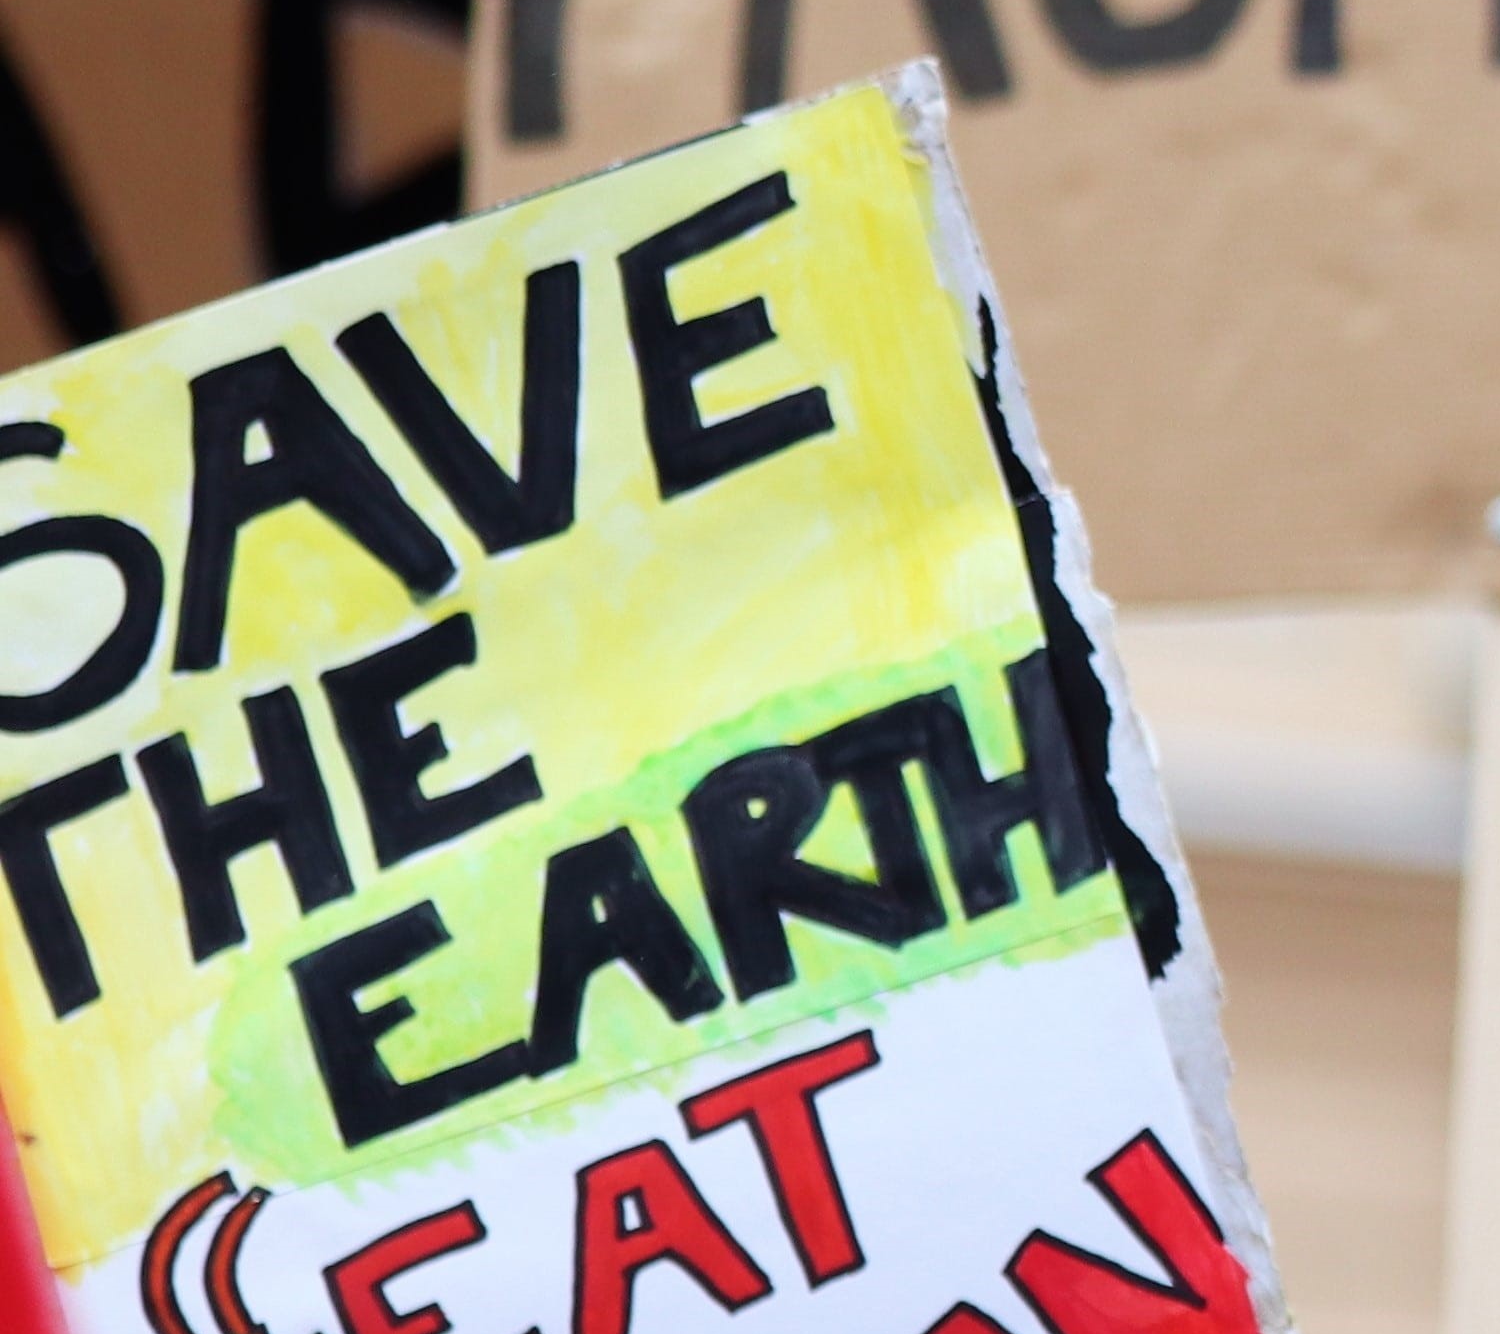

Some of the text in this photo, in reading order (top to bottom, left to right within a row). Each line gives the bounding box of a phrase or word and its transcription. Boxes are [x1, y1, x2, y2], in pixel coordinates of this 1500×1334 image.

[0, 170, 836, 733] SAVE
[0, 610, 544, 1021] THE
[287, 647, 1110, 1150] EARTH
